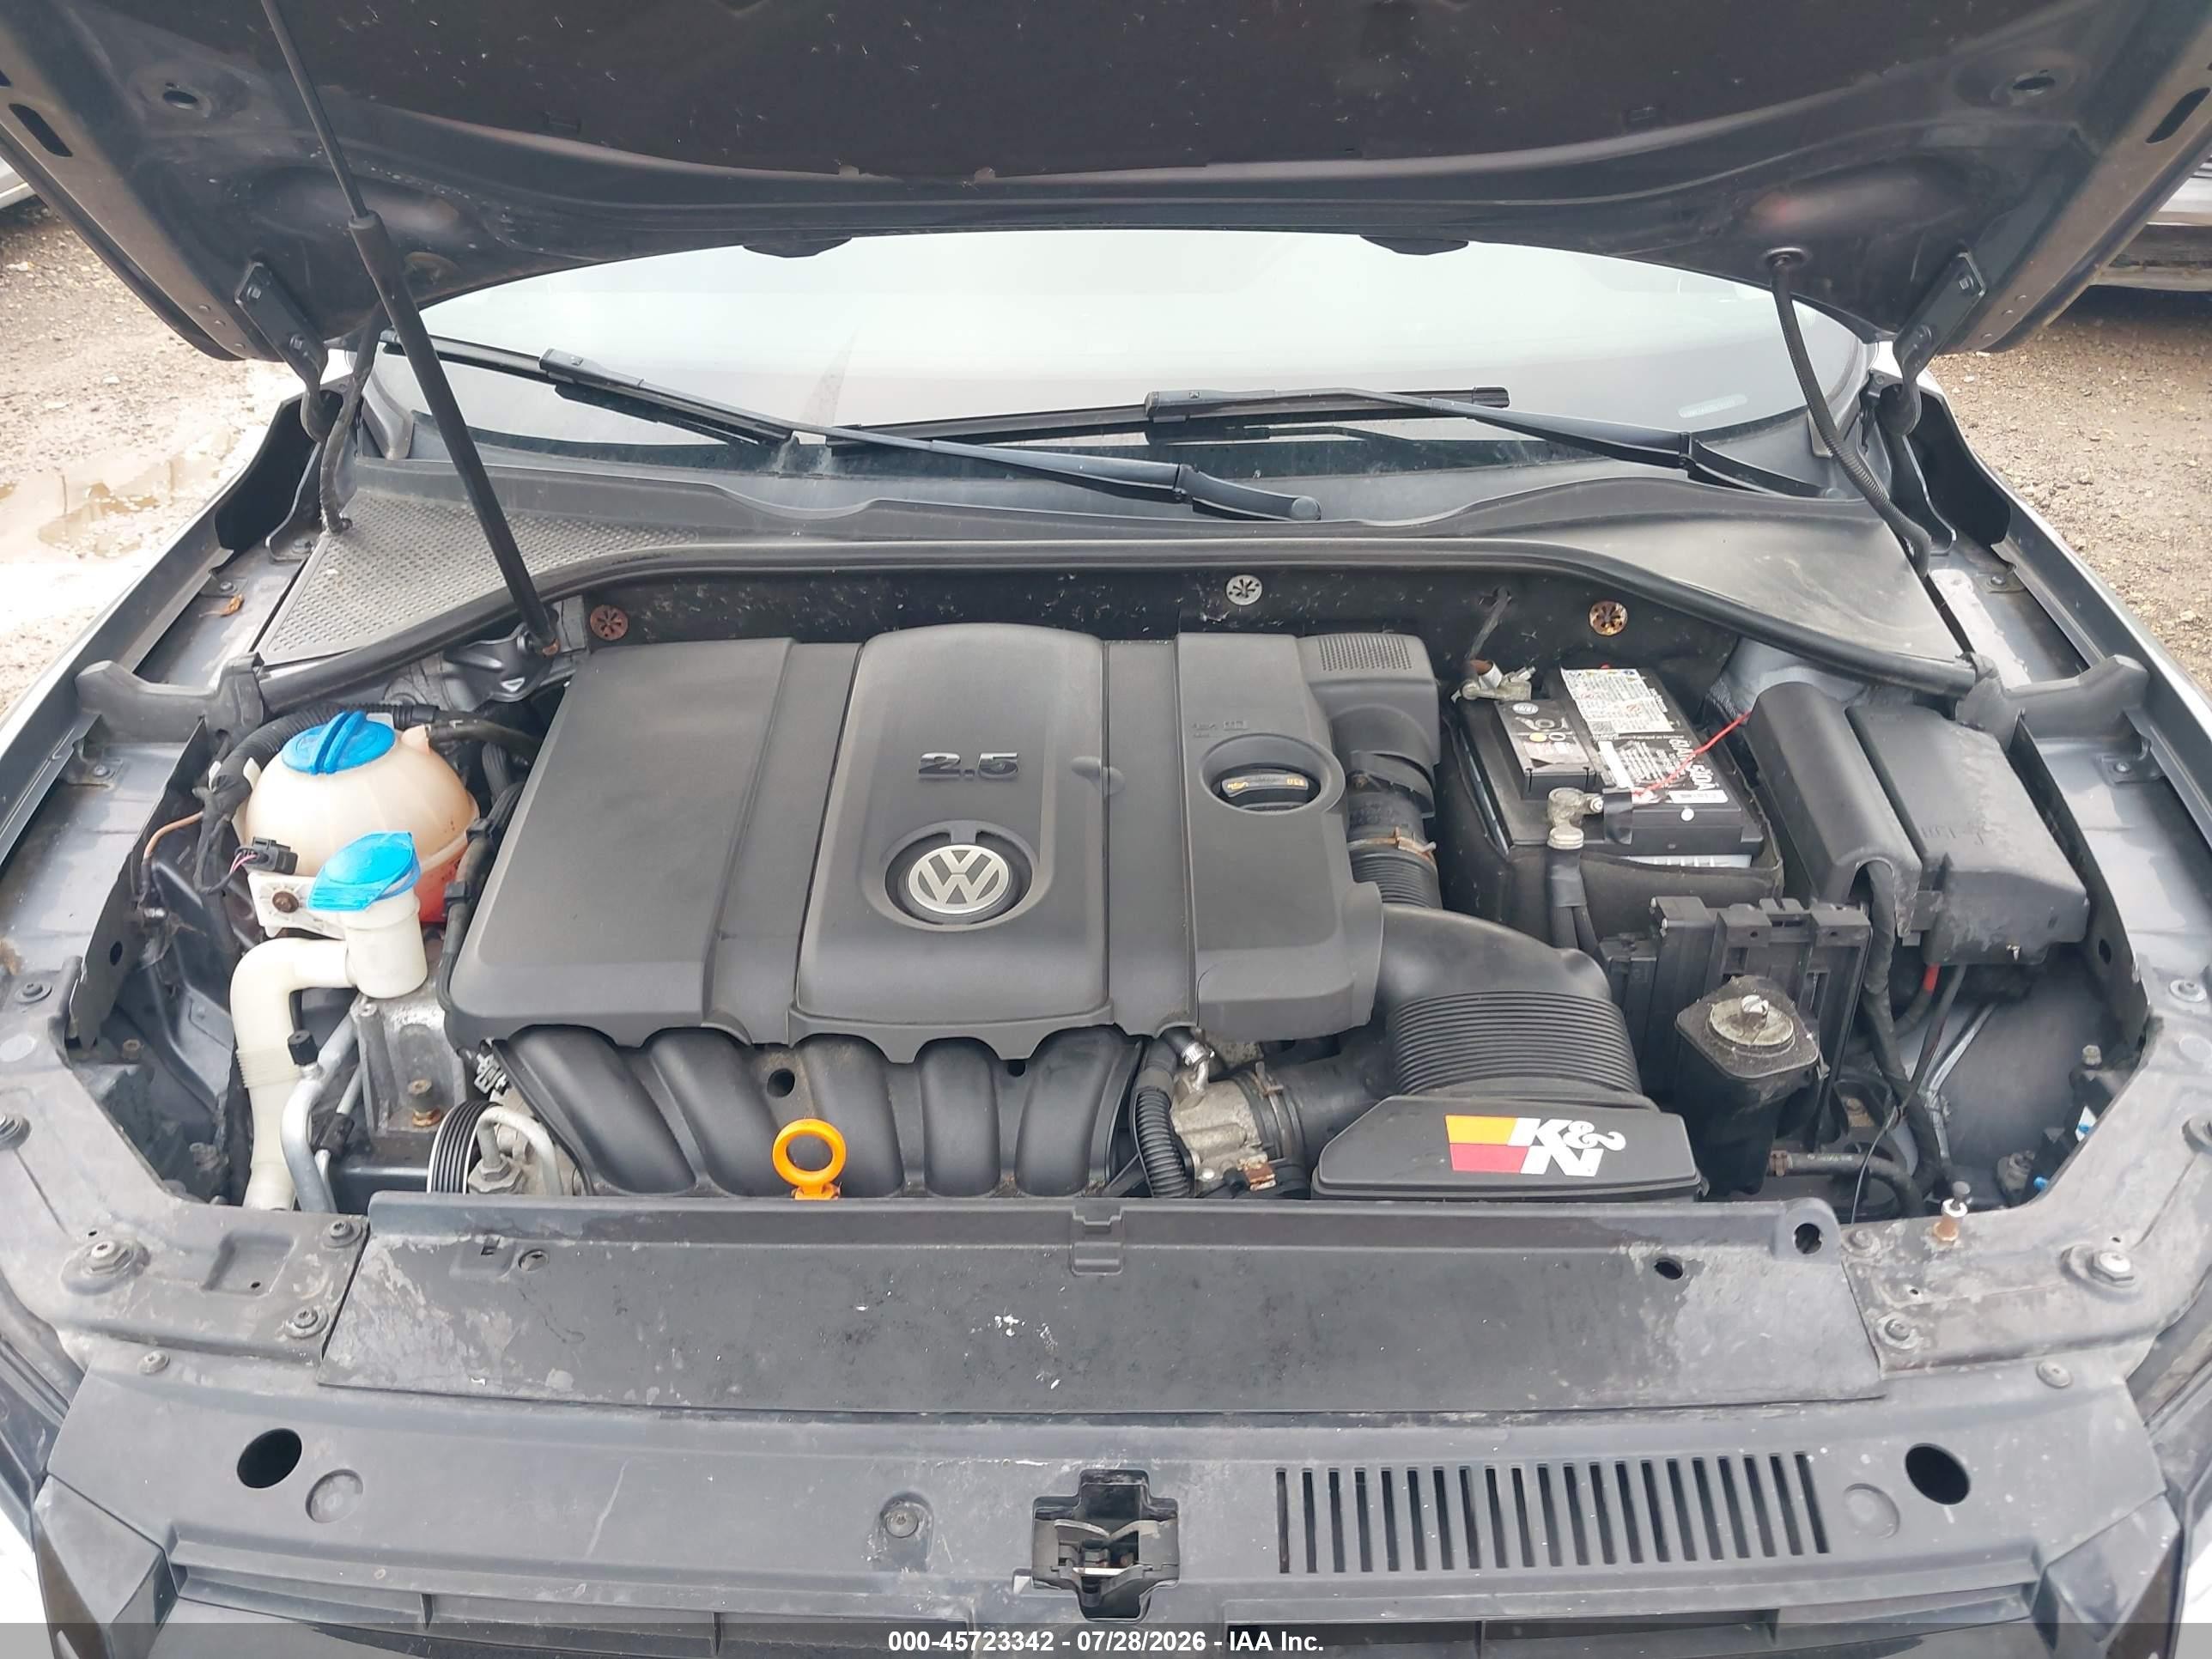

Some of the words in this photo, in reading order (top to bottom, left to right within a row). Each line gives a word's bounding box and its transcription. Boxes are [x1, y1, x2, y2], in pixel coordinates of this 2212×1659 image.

[919, 752, 1018, 778] 2.5
[908, 844, 1009, 914] VW
[1507, 1117, 1626, 1177] K&N
